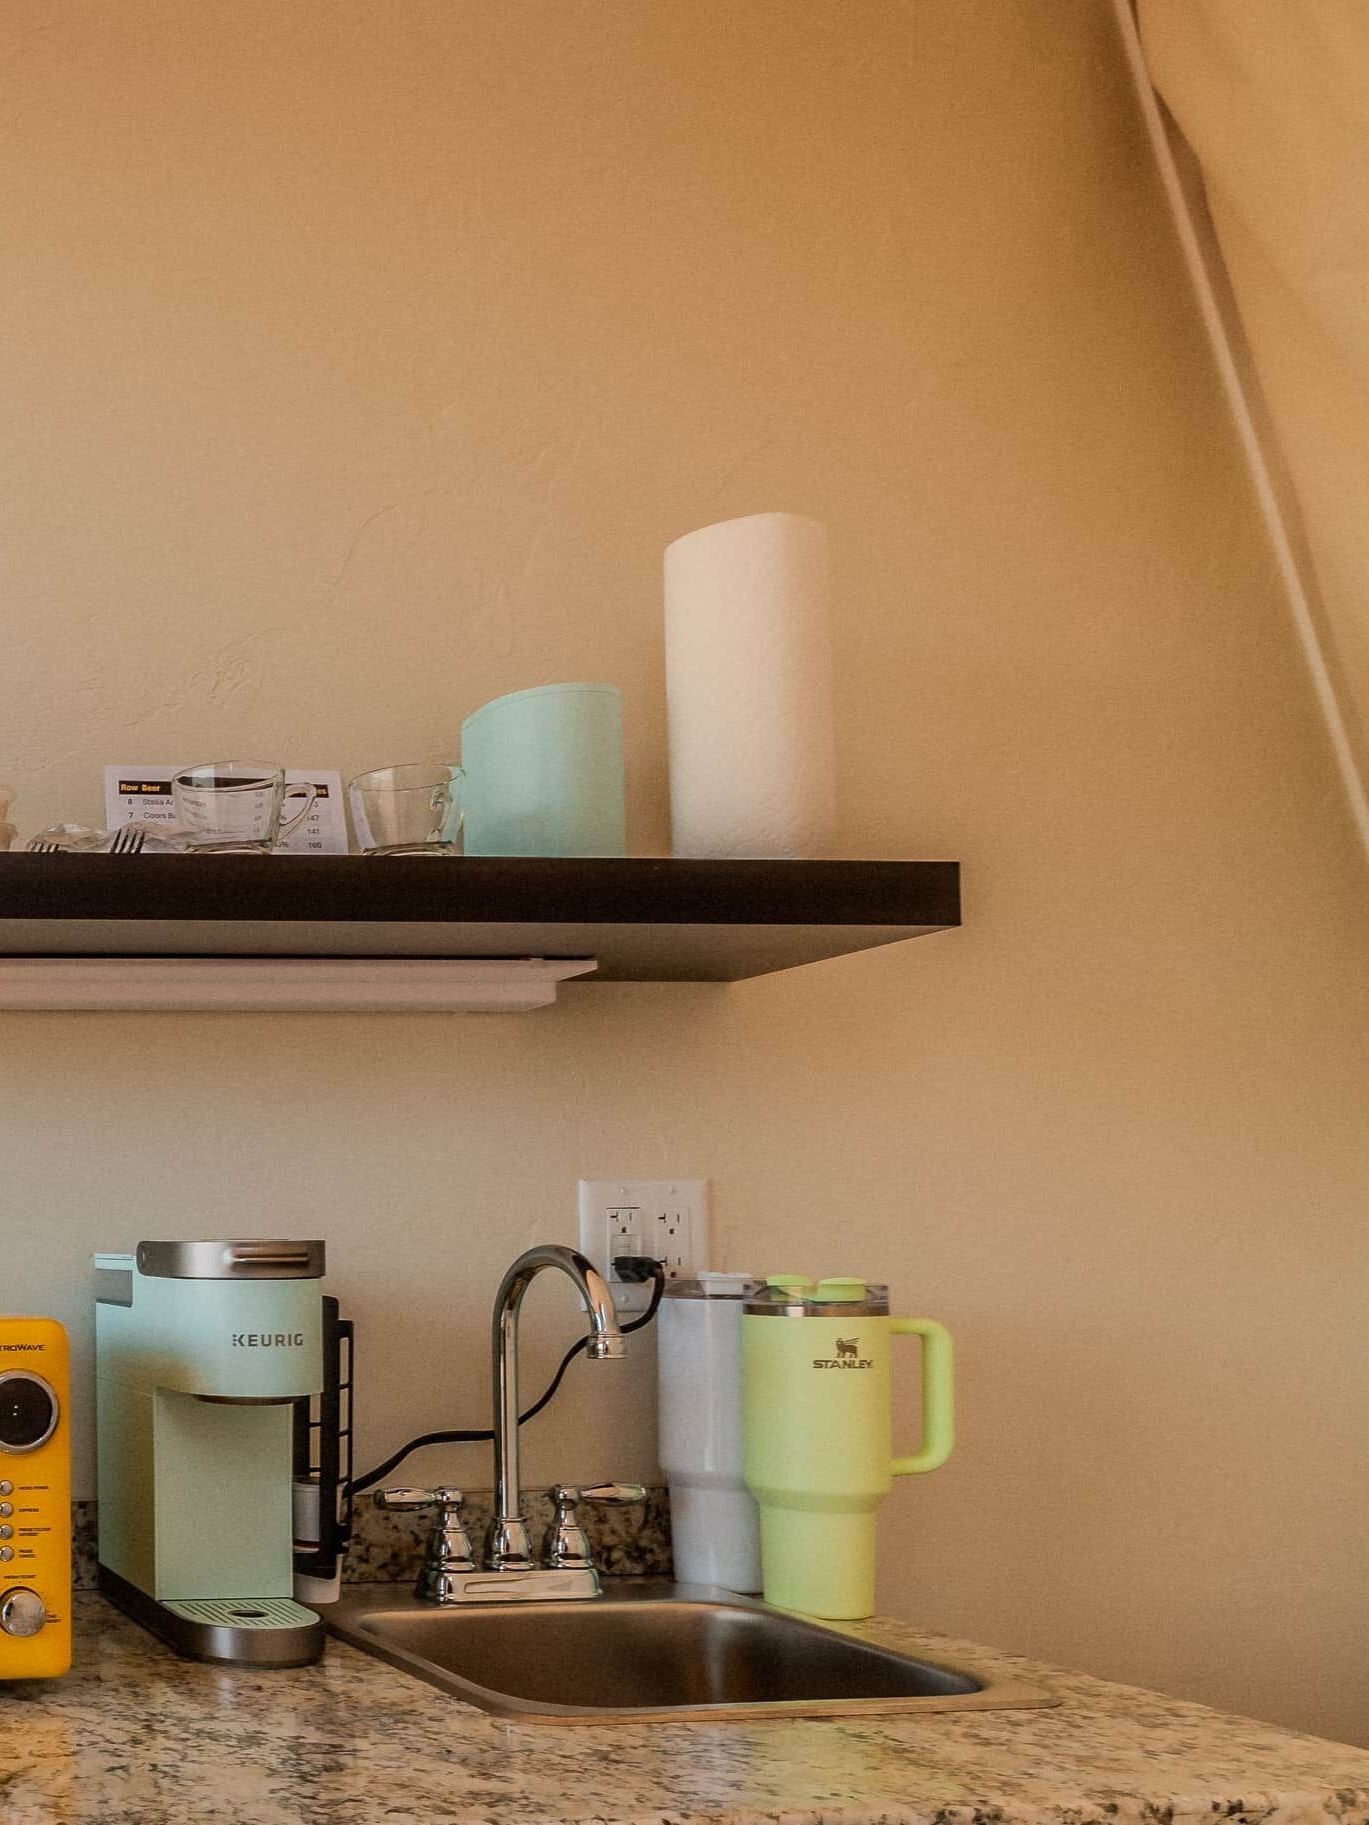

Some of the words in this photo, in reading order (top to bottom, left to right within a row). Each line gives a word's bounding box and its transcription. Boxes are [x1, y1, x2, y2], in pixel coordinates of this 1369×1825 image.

[120, 783, 139, 791] Row
[141, 784, 161, 792] Beer
[142, 798, 165, 806] Stella
[143, 811, 167, 819] Coors
[231, 1333, 304, 1347] KEURIG
[812, 1359, 874, 1369] STANLEY
